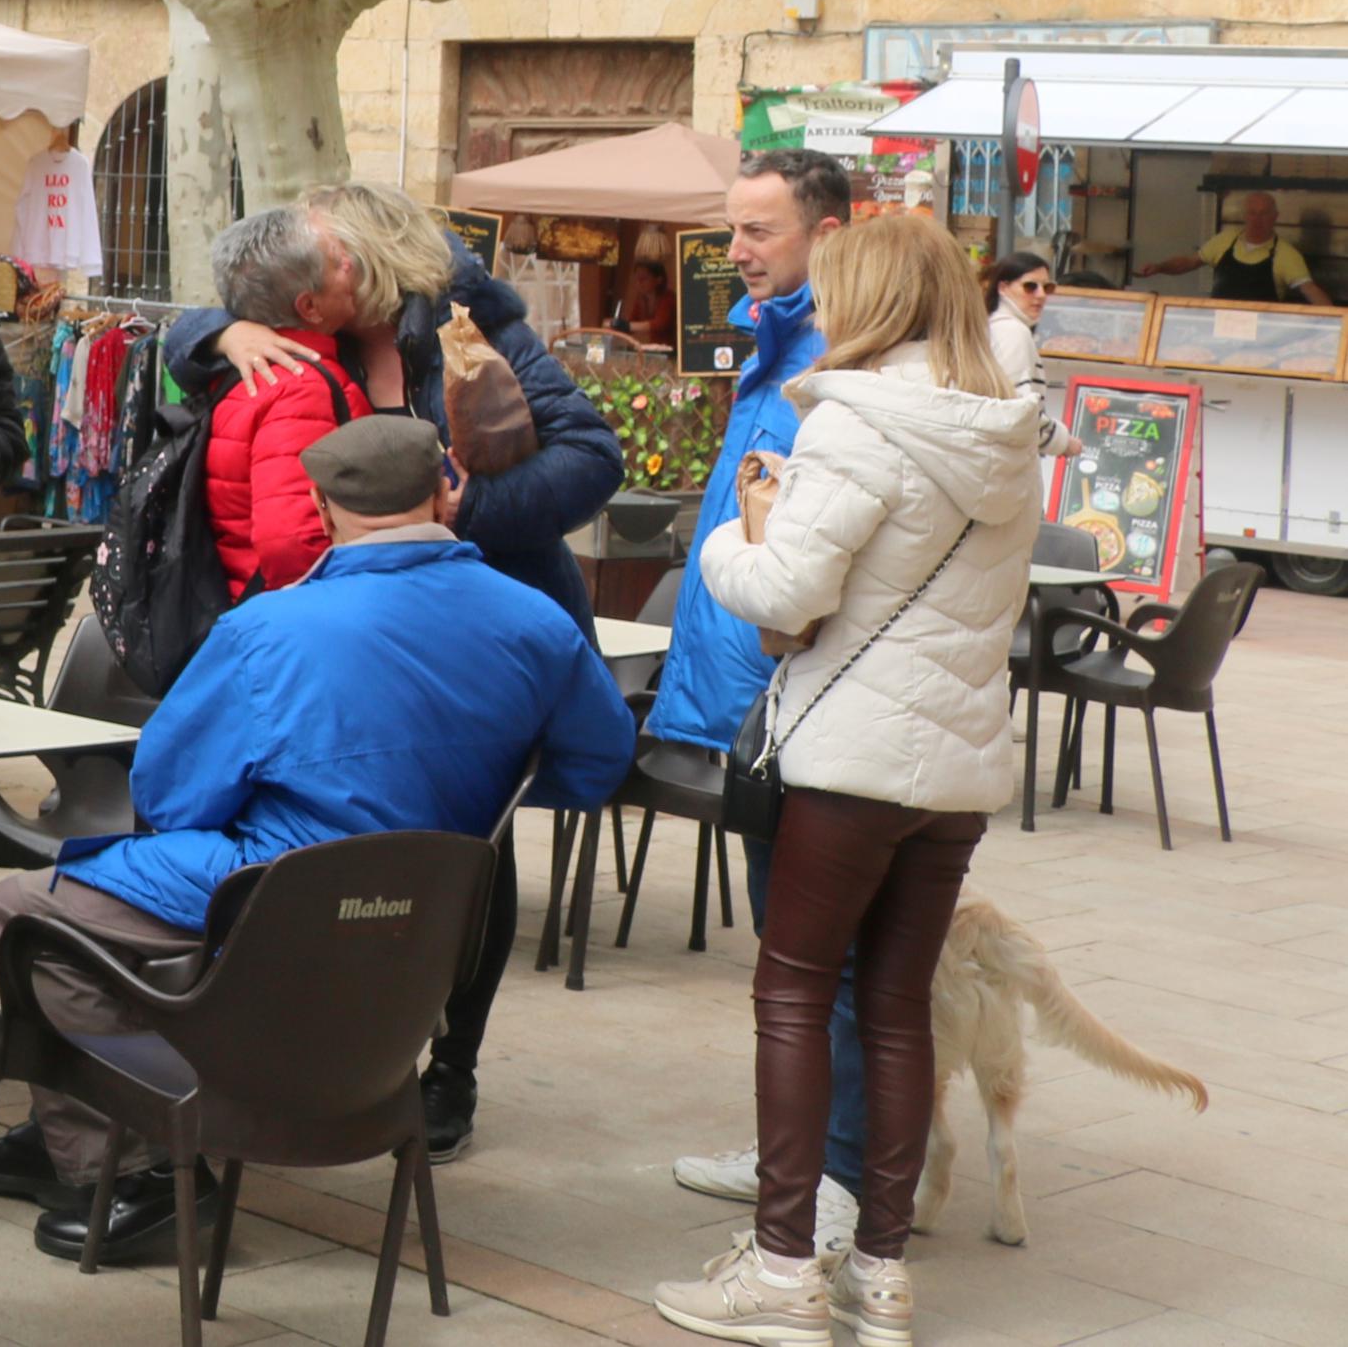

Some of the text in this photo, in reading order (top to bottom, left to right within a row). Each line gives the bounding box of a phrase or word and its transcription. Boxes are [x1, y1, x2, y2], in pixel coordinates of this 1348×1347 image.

[800, 98, 885, 113] Trattoria
[45, 174, 70, 188] LLO
[48, 194, 68, 208] RO
[1096, 416, 1161, 442] PIZZA
[338, 895, 412, 920] Mahou
